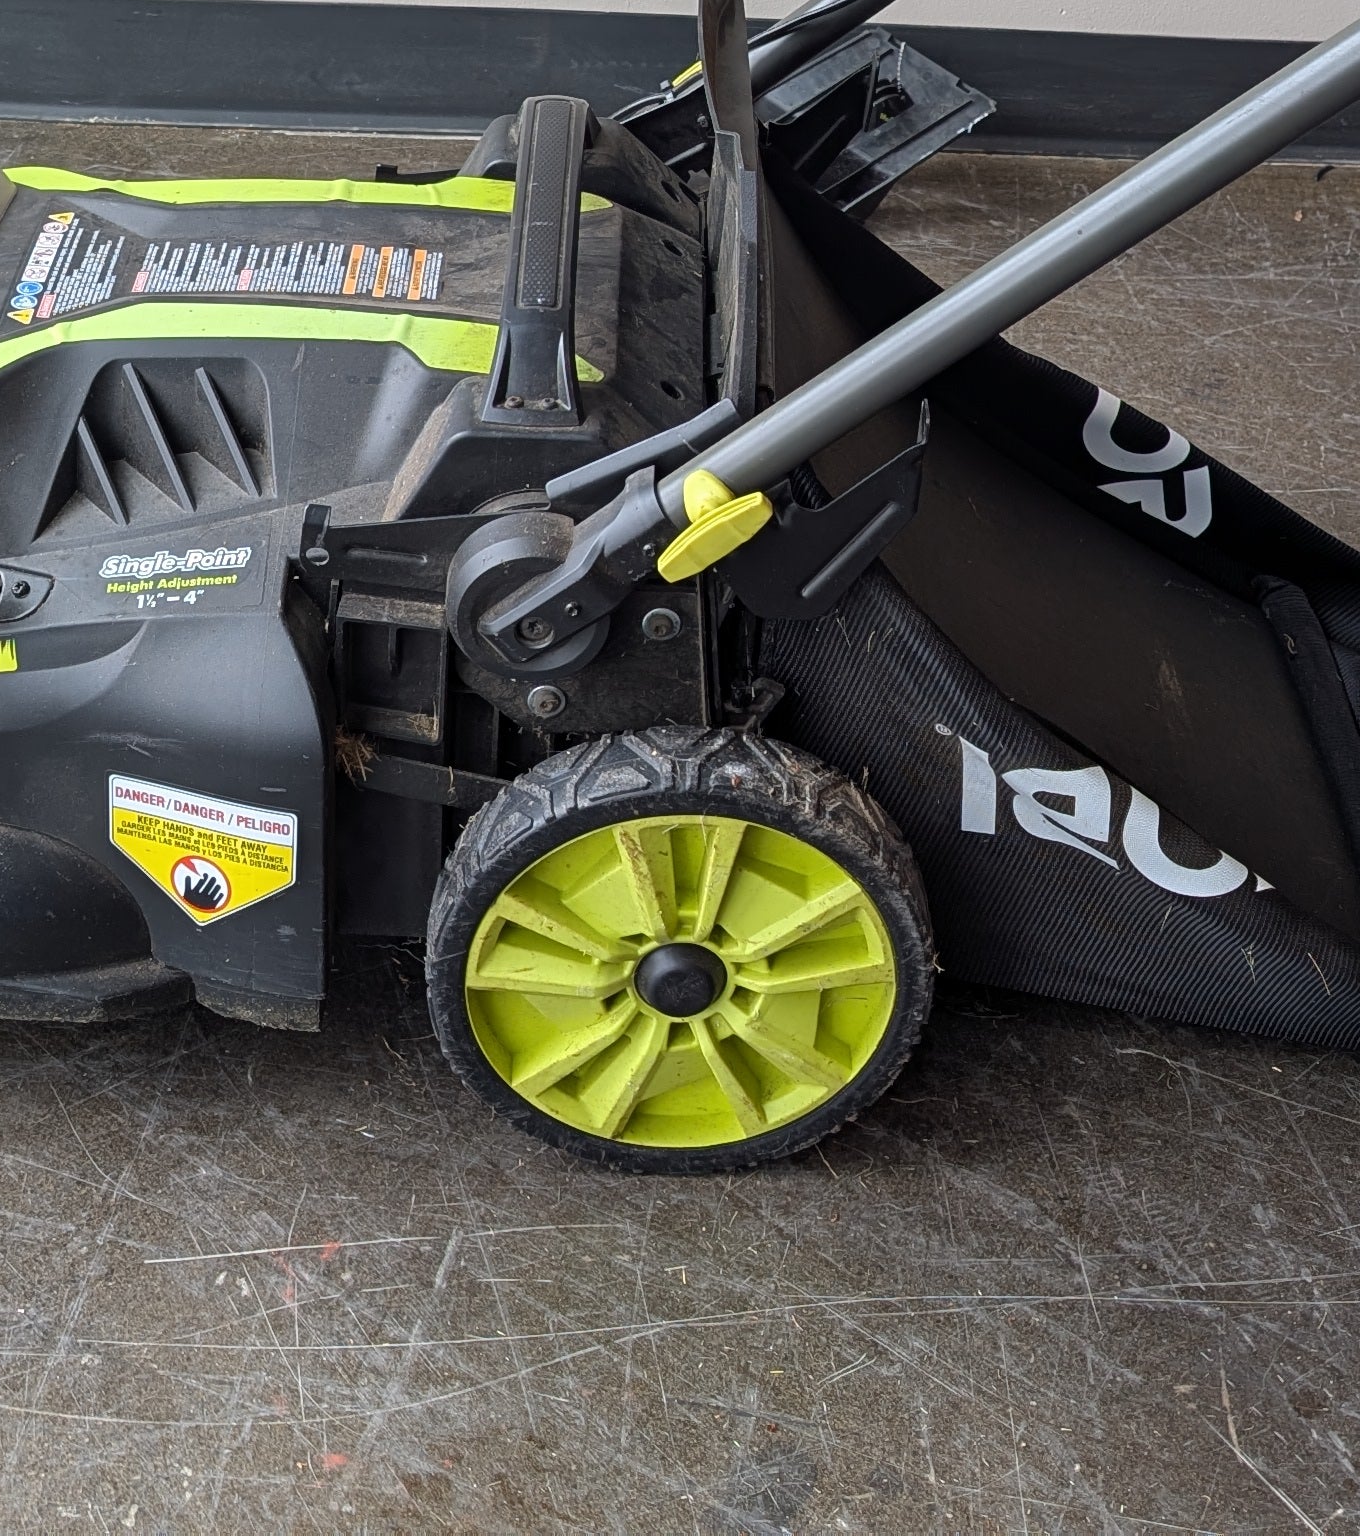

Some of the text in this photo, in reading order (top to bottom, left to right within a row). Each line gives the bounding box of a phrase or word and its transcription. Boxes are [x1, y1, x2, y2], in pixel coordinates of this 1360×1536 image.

[100, 547, 250, 578] Single-Point
[107, 574, 237, 594] Height Adjustment
[115, 786, 165, 808] DANGER
[174, 800, 224, 823] DANGER
[237, 815, 290, 836] PELIGRO
[138, 815, 267, 853] KEEP HANDS and FEET AWAY
[159, 837, 172, 846] LAS
